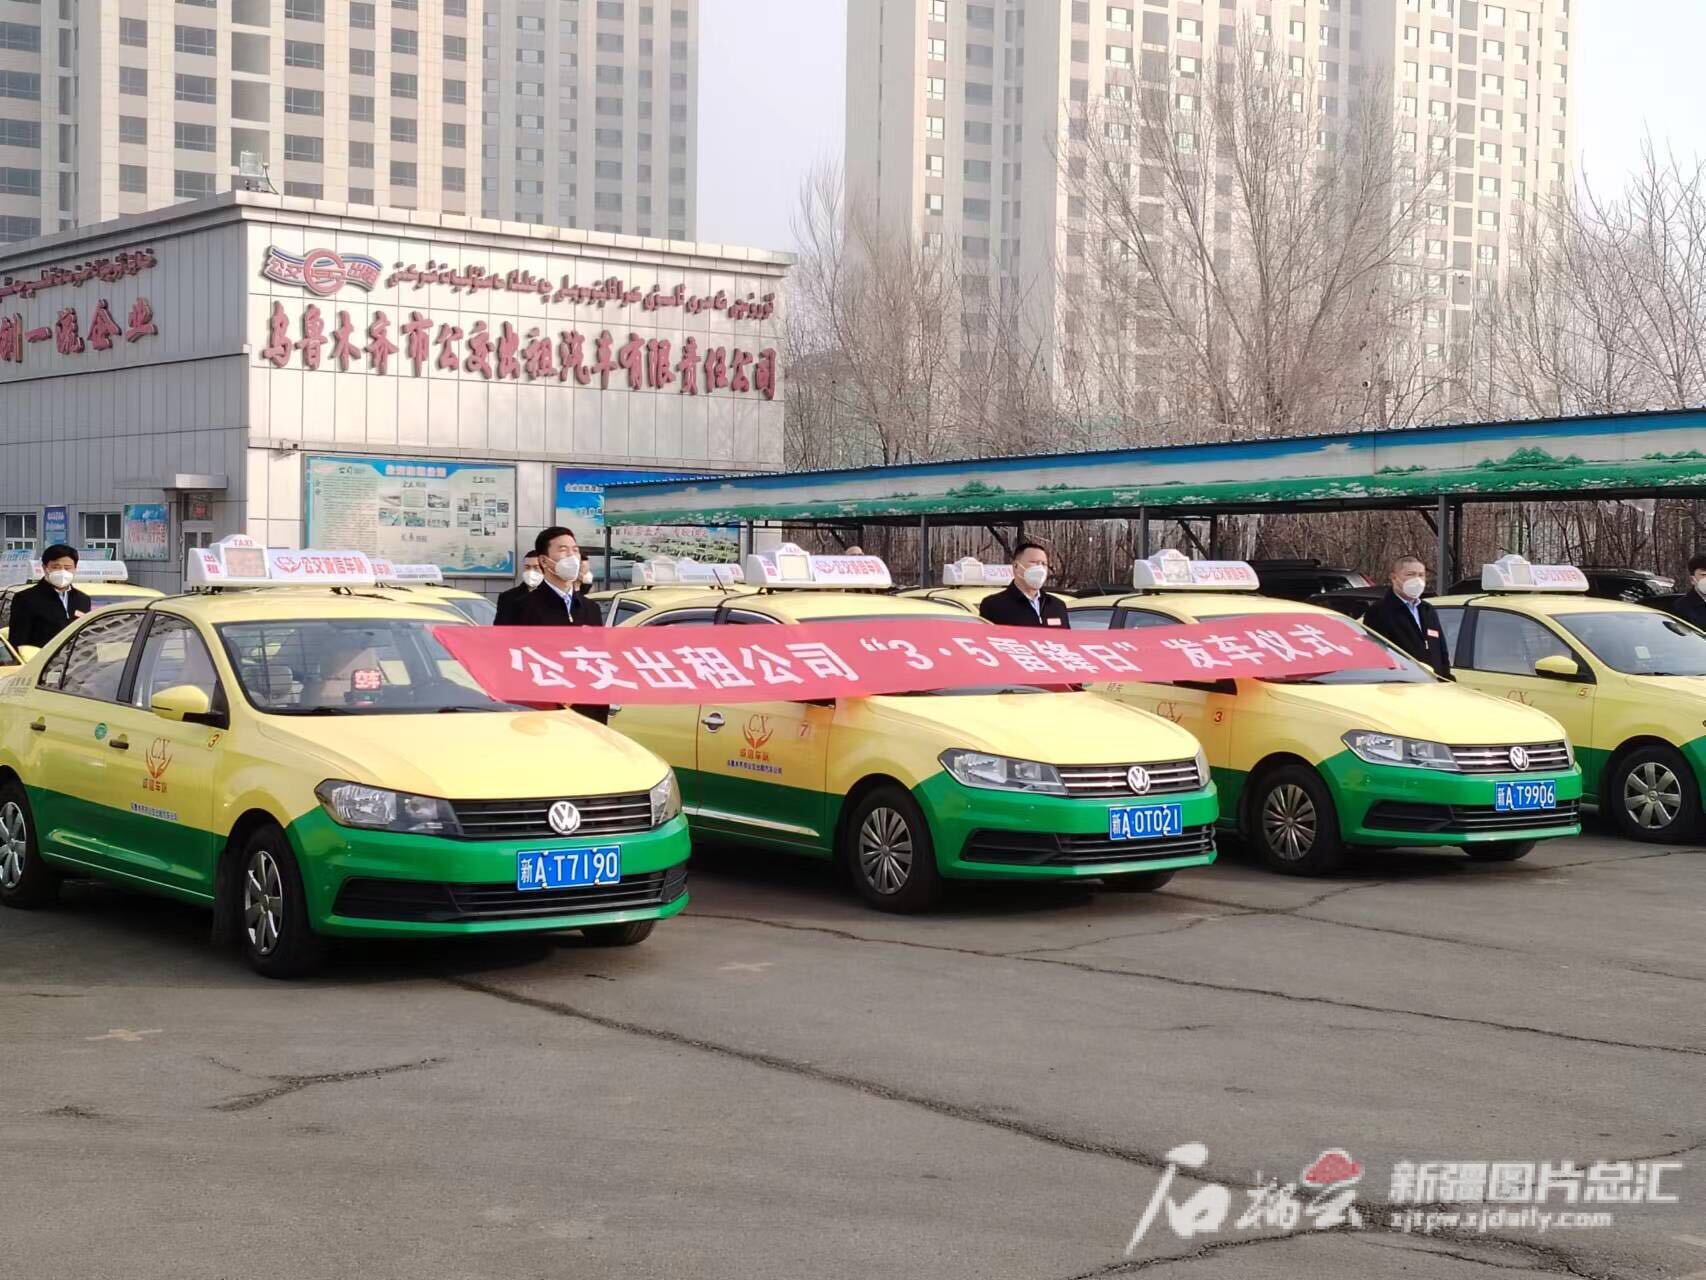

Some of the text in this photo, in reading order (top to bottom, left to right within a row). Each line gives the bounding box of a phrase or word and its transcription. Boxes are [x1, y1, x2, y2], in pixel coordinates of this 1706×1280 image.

[263, 300, 777, 400] 乌鲁木齐市公交出租汽车有限责任公司
